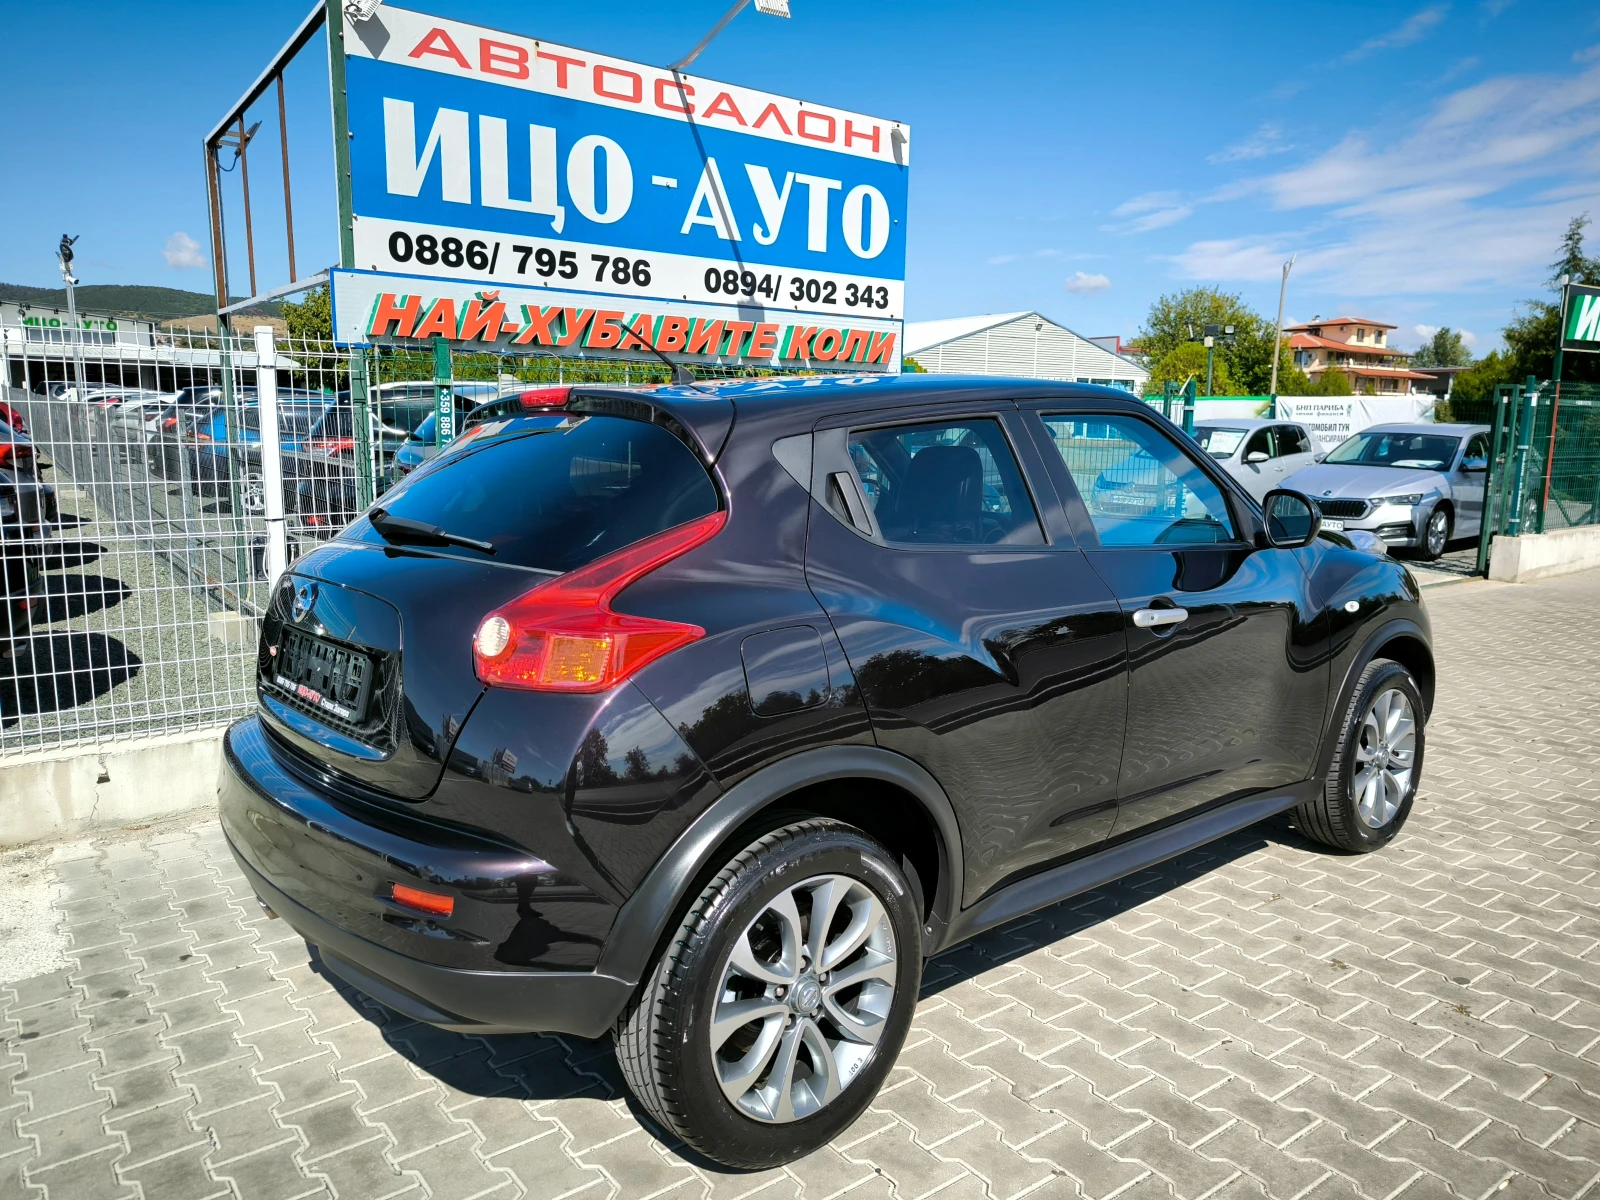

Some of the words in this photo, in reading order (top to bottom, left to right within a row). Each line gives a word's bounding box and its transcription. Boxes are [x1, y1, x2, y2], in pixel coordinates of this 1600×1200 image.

[407, 27, 881, 154] АВТОСАЛОН
[388, 231, 500, 275] 0886/
[512, 244, 578, 280] 795
[590, 253, 652, 287] 786
[704, 267, 783, 302] 0894/
[789, 276, 837, 305] 302
[844, 283, 889, 310] 343
[23, 316, 118, 331] ИЦО-УТО
[367, 289, 780, 359] НАЙ-ХУБАВИТЕ
[781, 325, 897, 365] КОЛИ
[440, 388, 450, 414] +359
[440, 416, 451, 436] 886
[1338, 423, 1350, 432] ТУК
